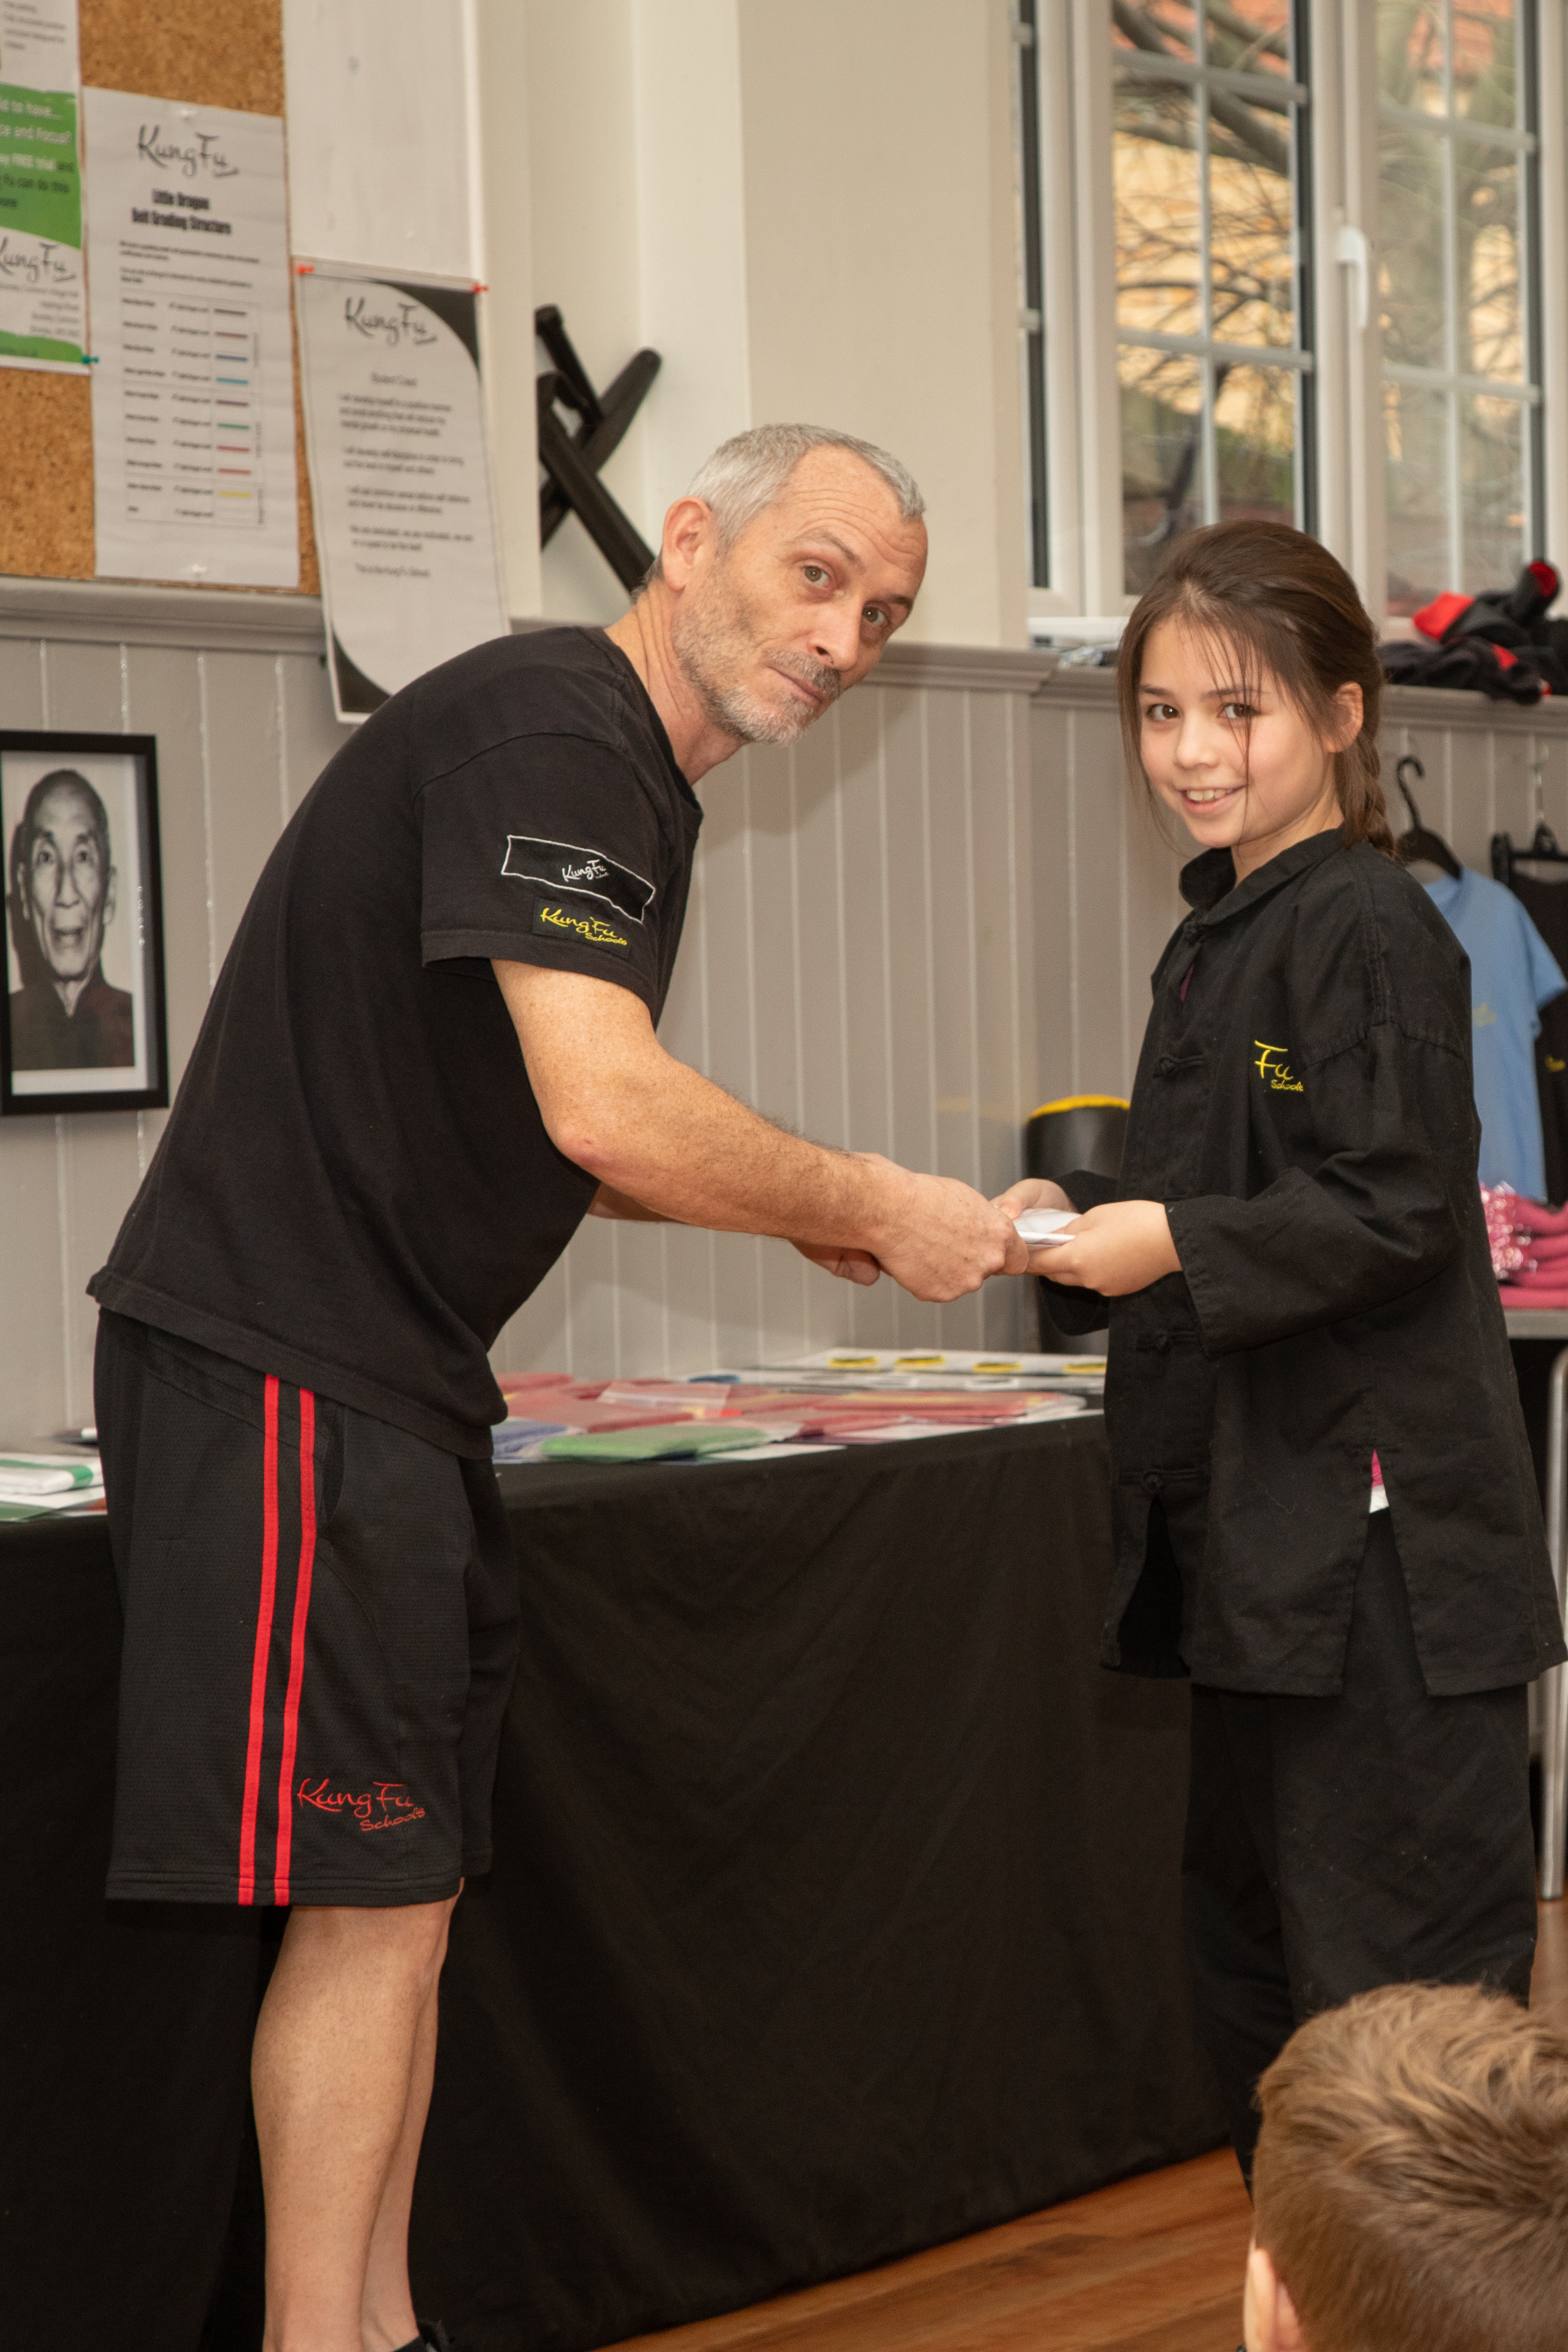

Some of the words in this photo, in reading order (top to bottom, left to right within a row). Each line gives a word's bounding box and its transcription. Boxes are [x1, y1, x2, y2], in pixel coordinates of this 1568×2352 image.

[562, 864, 594, 883] Kung
[586, 859, 607, 875] Fu
[540, 907, 590, 933] Kung
[590, 916, 618, 938] Fu
[585, 931, 628, 946] Schools
[1254, 1040, 1294, 1080] Fu
[297, 1778, 372, 1818] Kung
[373, 1781, 414, 1811] Fu
[360, 1807, 426, 1832] Schools
